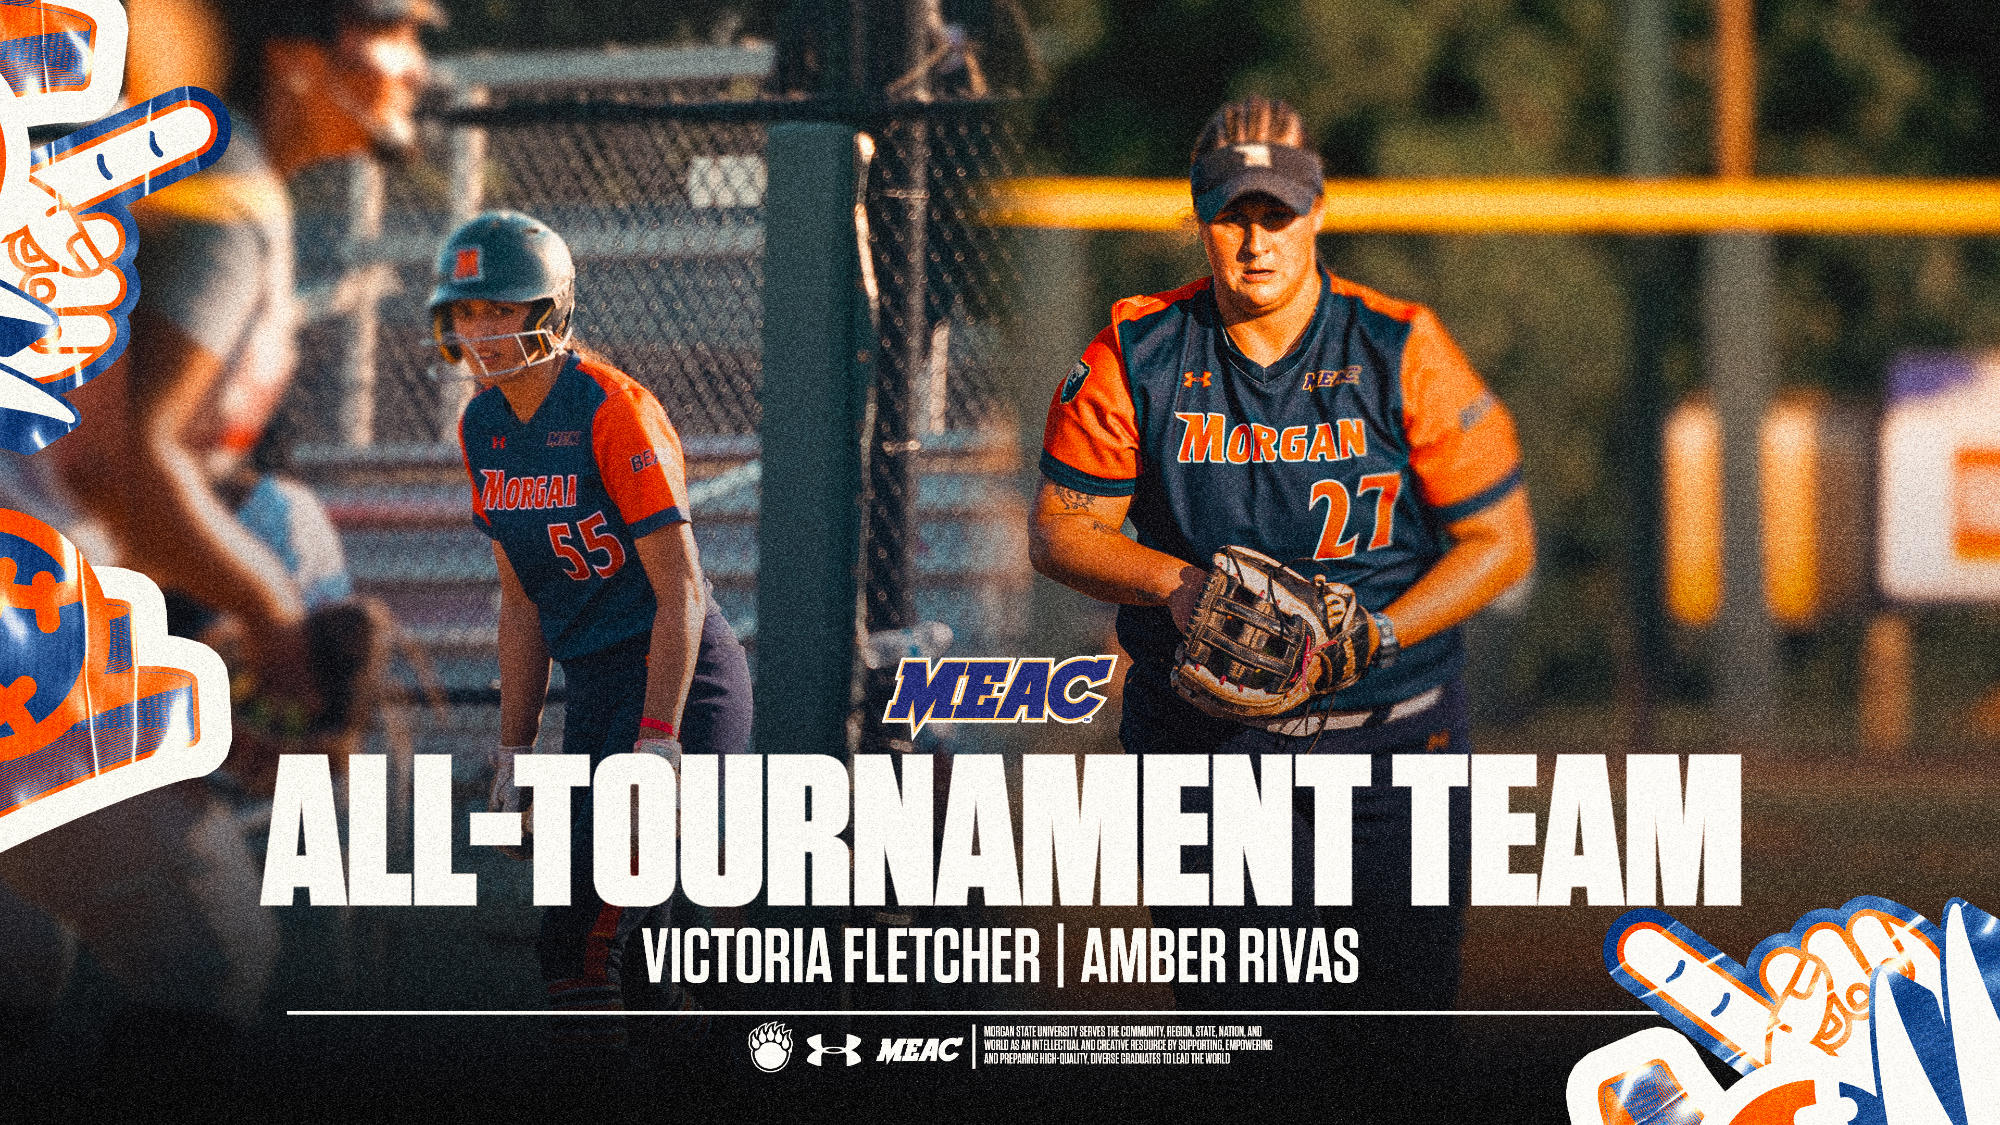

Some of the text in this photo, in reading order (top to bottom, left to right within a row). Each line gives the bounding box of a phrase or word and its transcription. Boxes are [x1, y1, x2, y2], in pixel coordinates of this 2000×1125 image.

[1174, 411, 1368, 464] MORGAN
[547, 510, 626, 581] 55
[1308, 471, 1402, 561] 27
